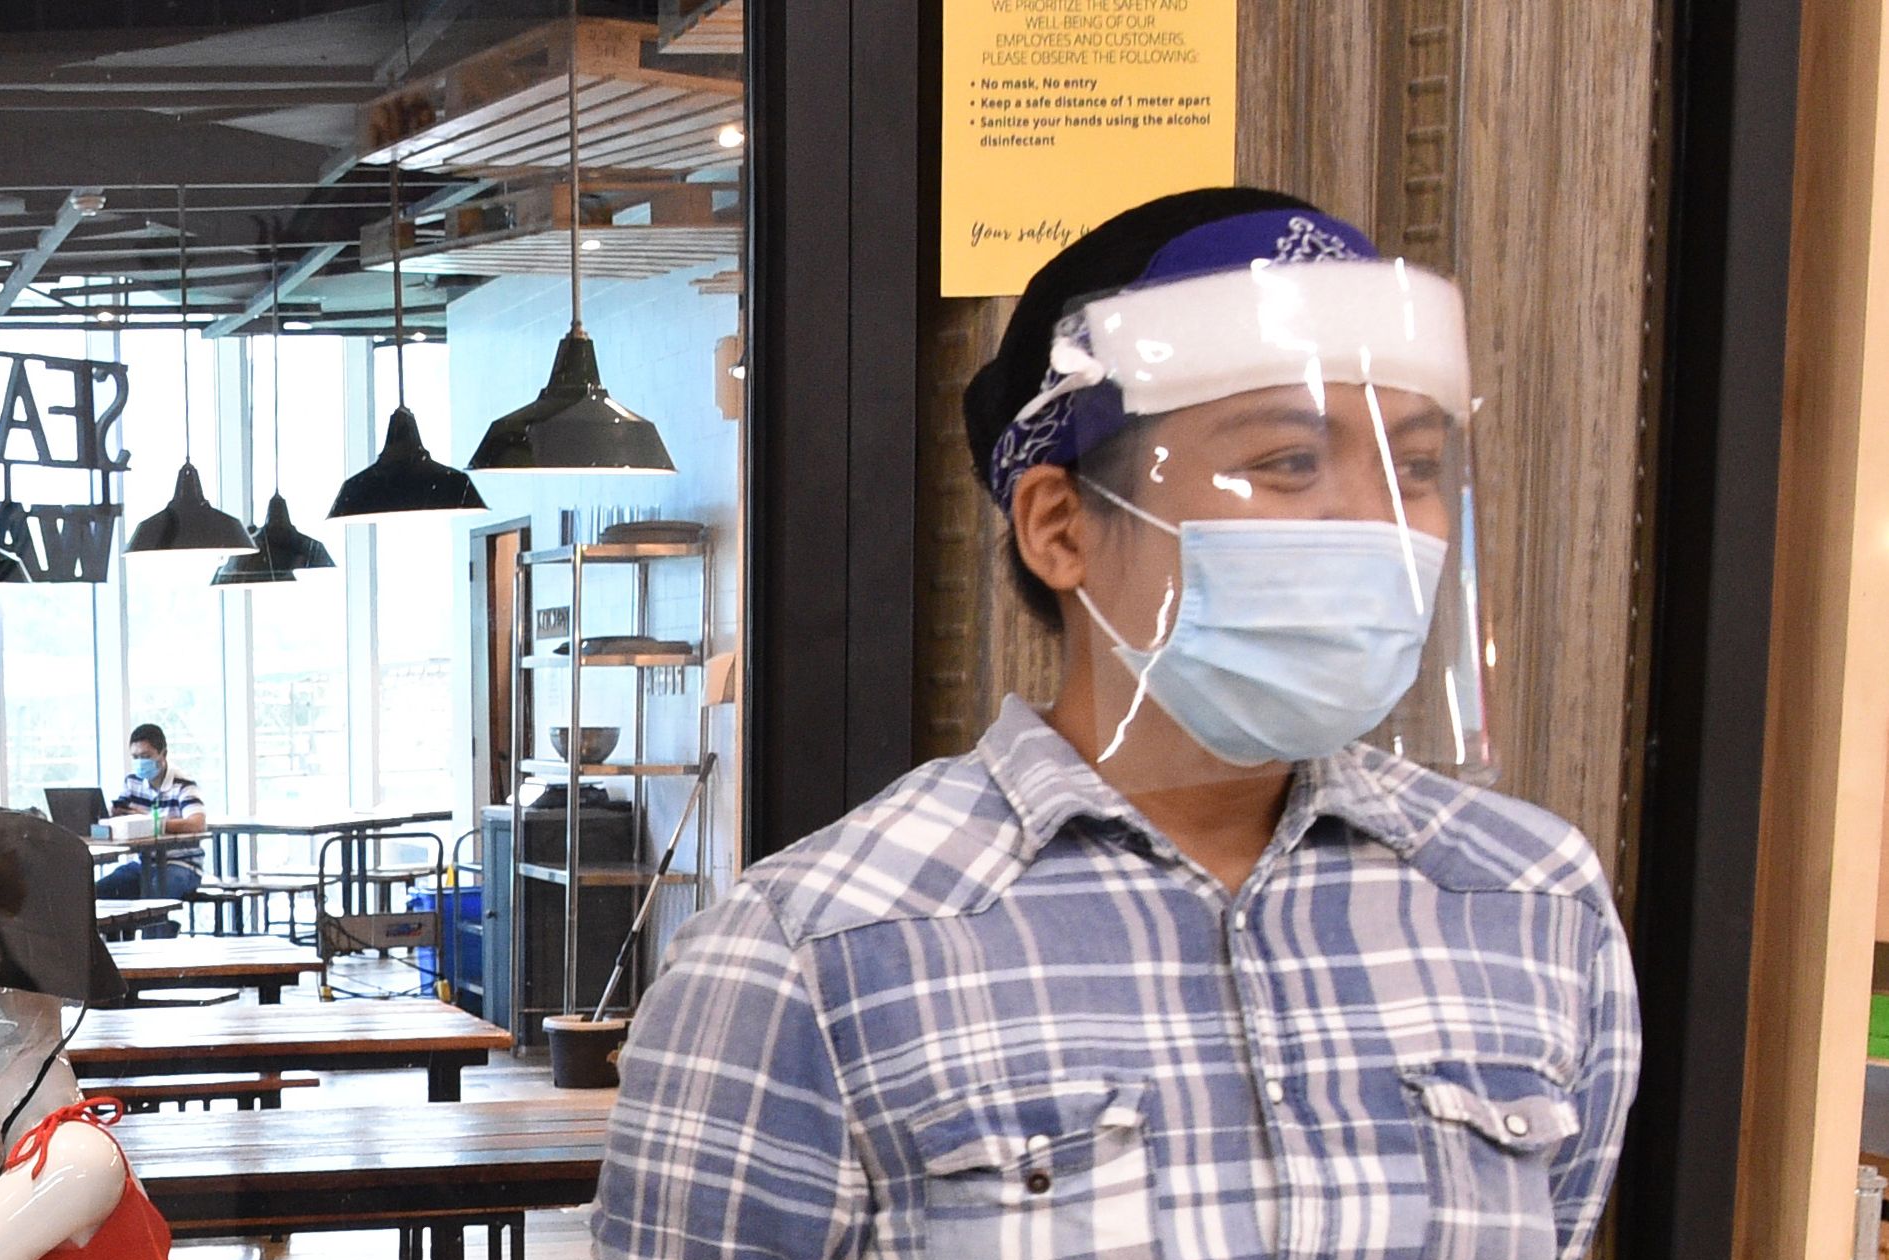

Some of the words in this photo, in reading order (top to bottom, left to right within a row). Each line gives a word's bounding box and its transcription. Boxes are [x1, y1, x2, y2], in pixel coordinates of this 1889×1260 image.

[1015, 0, 1083, 12] PRIORITIZE
[1087, 0, 1108, 11] THE
[1112, 0, 1156, 11] SAFETY
[1160, 0, 1188, 11] AND
[1105, 15, 1123, 28] OF
[1126, 15, 1155, 28] OUR
[996, 33, 1071, 48] EMPLOYEES
[1074, 33, 1102, 47] AND
[982, 52, 1027, 66] PLEASE
[1030, 52, 1088, 66] OBSERVE
[1092, 51, 1116, 65] THE
[981, 78, 999, 90] No
[1002, 78, 1039, 91] mask,
[1042, 78, 1060, 89] No
[1064, 77, 1097, 92] entry
[981, 97, 1010, 111] Keep
[1015, 99, 1021, 108] a
[1025, 97, 1051, 108] safe
[1055, 96, 1107, 108] distance
[1110, 96, 1124, 107] of
[1126, 96, 1133, 107] 1
[1137, 96, 1174, 107] meter
[1178, 96, 1211, 110] apart
[980, 115, 1029, 128] Sanitize
[1033, 117, 1061, 130] your
[1064, 114, 1102, 127] hands
[1106, 114, 1139, 129] using
[1143, 113, 1163, 125] the
[1166, 112, 1211, 125] alcohol
[980, 135, 1055, 148] disinfectant
[971, 220, 1011, 247] Your
[1018, 219, 1071, 246] safety
